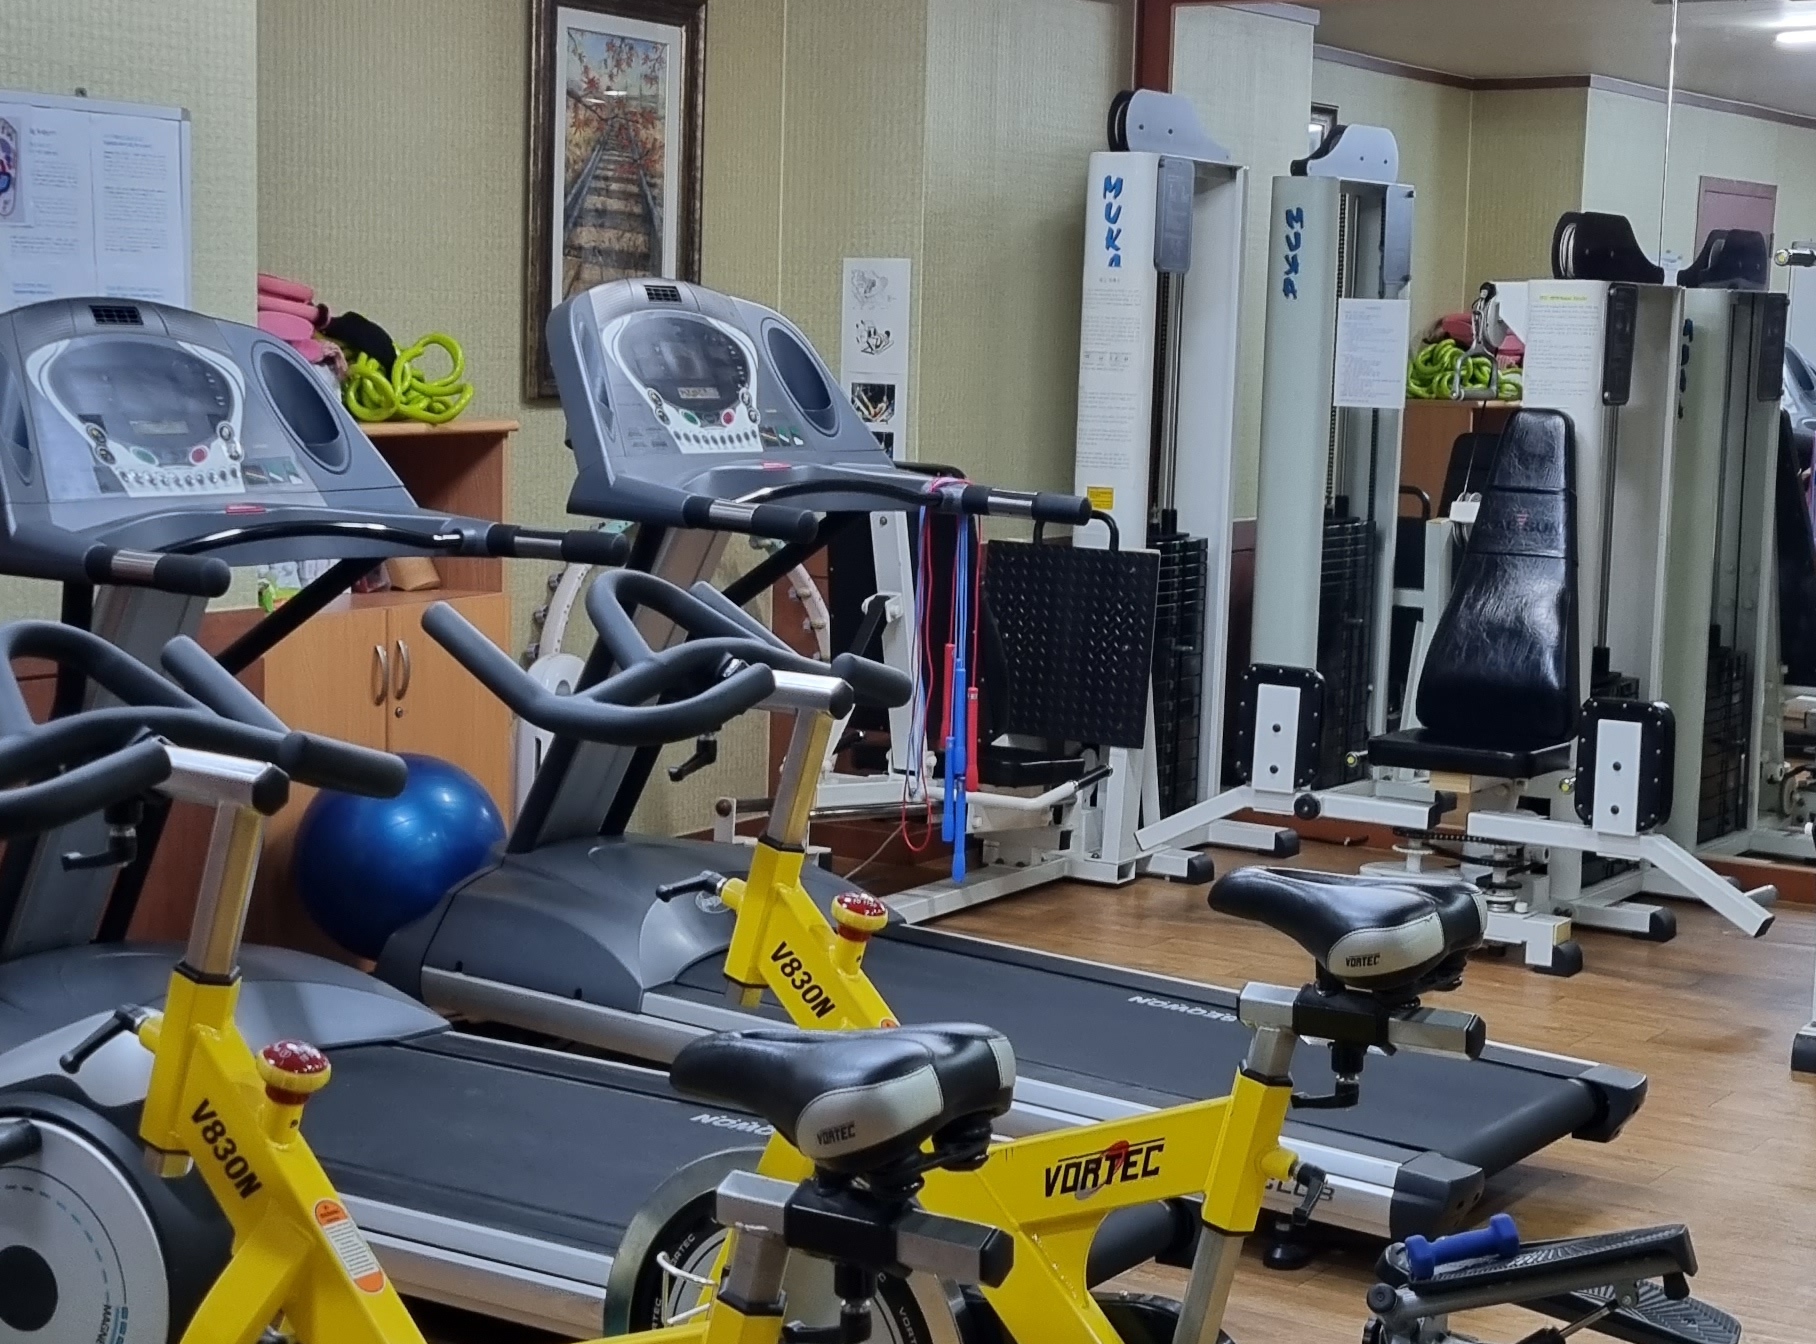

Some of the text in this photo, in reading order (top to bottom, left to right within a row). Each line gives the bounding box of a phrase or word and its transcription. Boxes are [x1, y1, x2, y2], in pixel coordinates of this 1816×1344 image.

[1346, 953, 1380, 967] VORTEC
[771, 941, 836, 1019] V830N
[192, 1098, 263, 1199] V830N
[816, 1120, 856, 1145] VORTEC
[1045, 1143, 1164, 1198] VORTEC
[670, 1233, 696, 1267] ORTEC
[652, 1297, 662, 1330] RTEC
